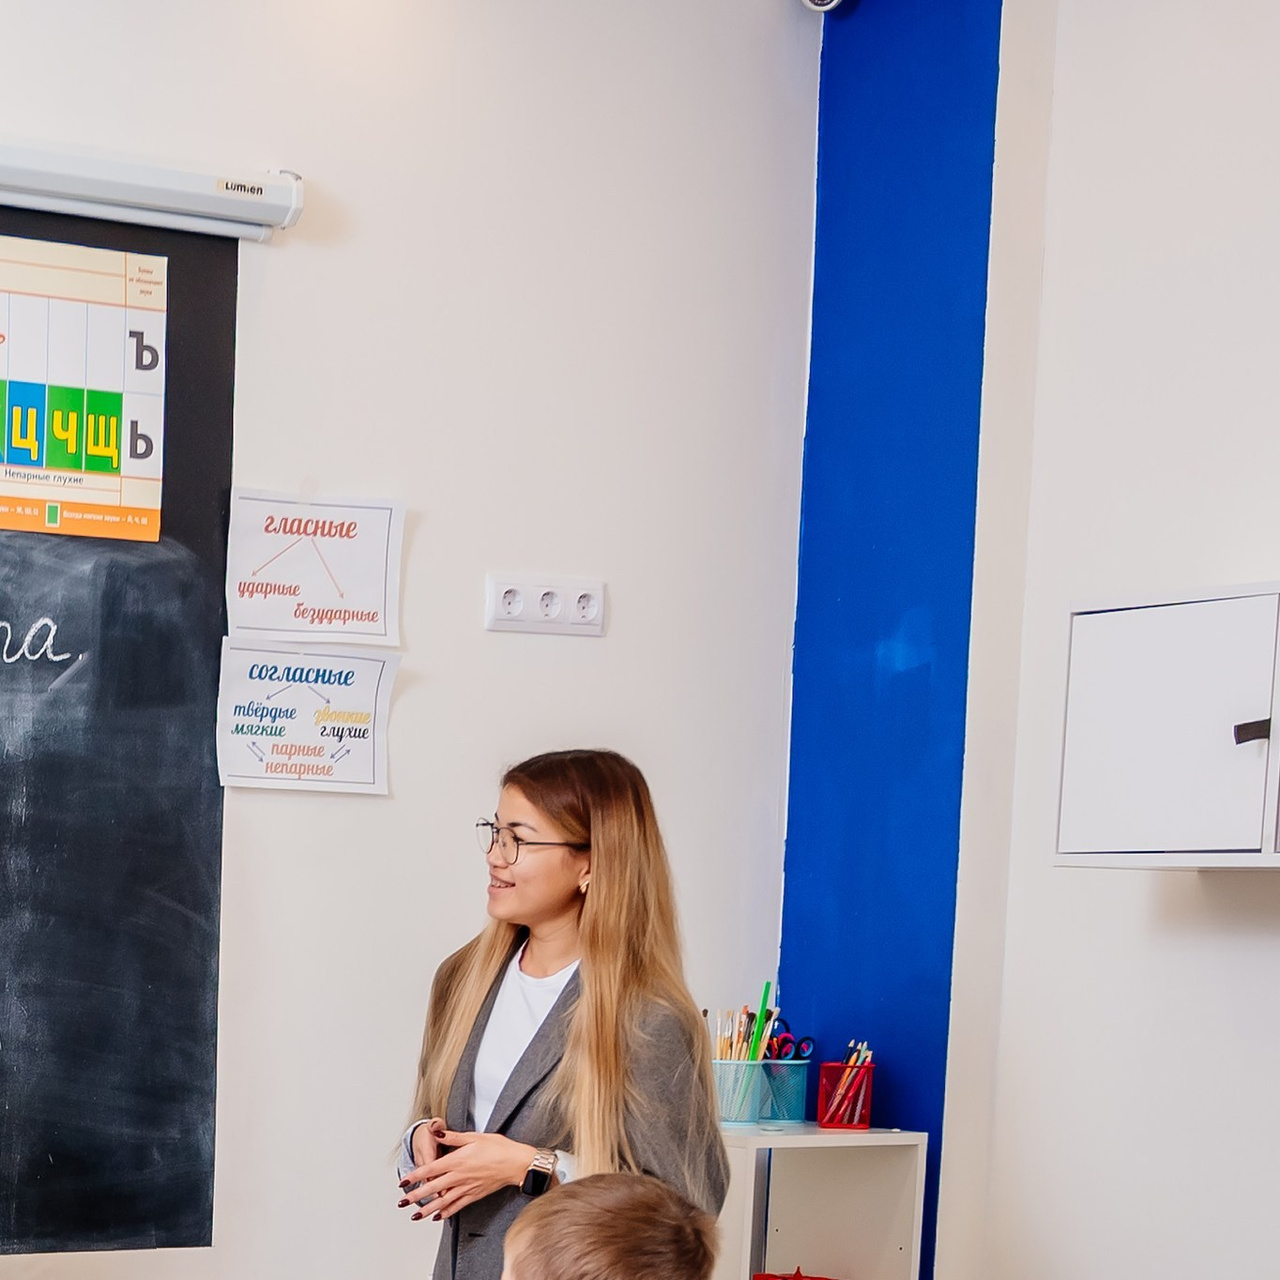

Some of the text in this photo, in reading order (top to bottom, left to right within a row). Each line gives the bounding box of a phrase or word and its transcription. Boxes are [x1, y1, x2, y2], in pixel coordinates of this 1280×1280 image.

[4, 469, 84, 486] Непарные глухие
[264, 515, 358, 539] гласные
[237, 580, 301, 598] ударные
[293, 602, 379, 624] безударные
[248, 663, 355, 686] согласные
[233, 701, 297, 723] твёрдые
[231, 723, 286, 738] мягкие
[320, 725, 370, 742] глухие
[271, 742, 325, 759] парные
[265, 760, 334, 780] непарные
